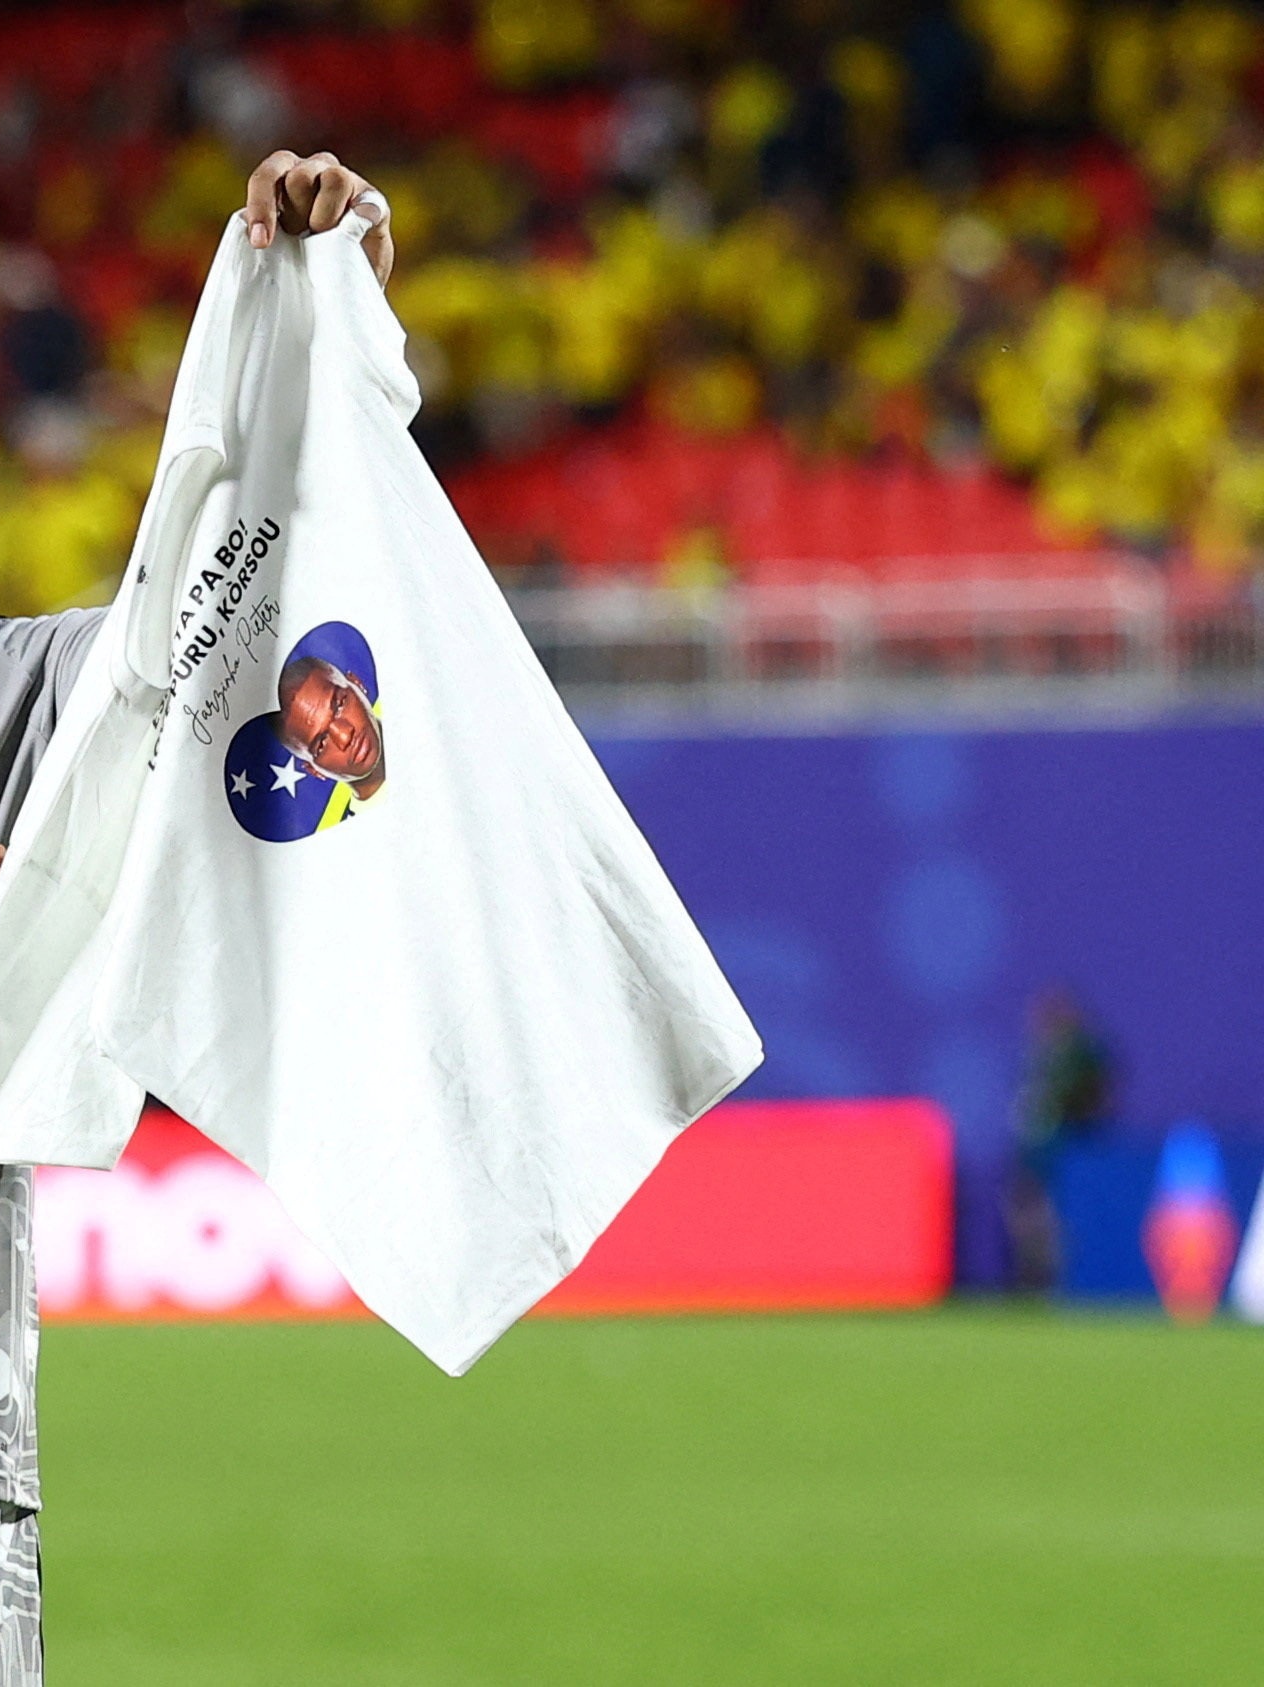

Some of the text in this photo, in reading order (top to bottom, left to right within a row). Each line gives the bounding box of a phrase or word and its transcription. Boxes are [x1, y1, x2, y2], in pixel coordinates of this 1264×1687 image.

[188, 570, 224, 606] PA
[214, 517, 248, 570] BO!
[216, 516, 281, 623] KÒRSOU
